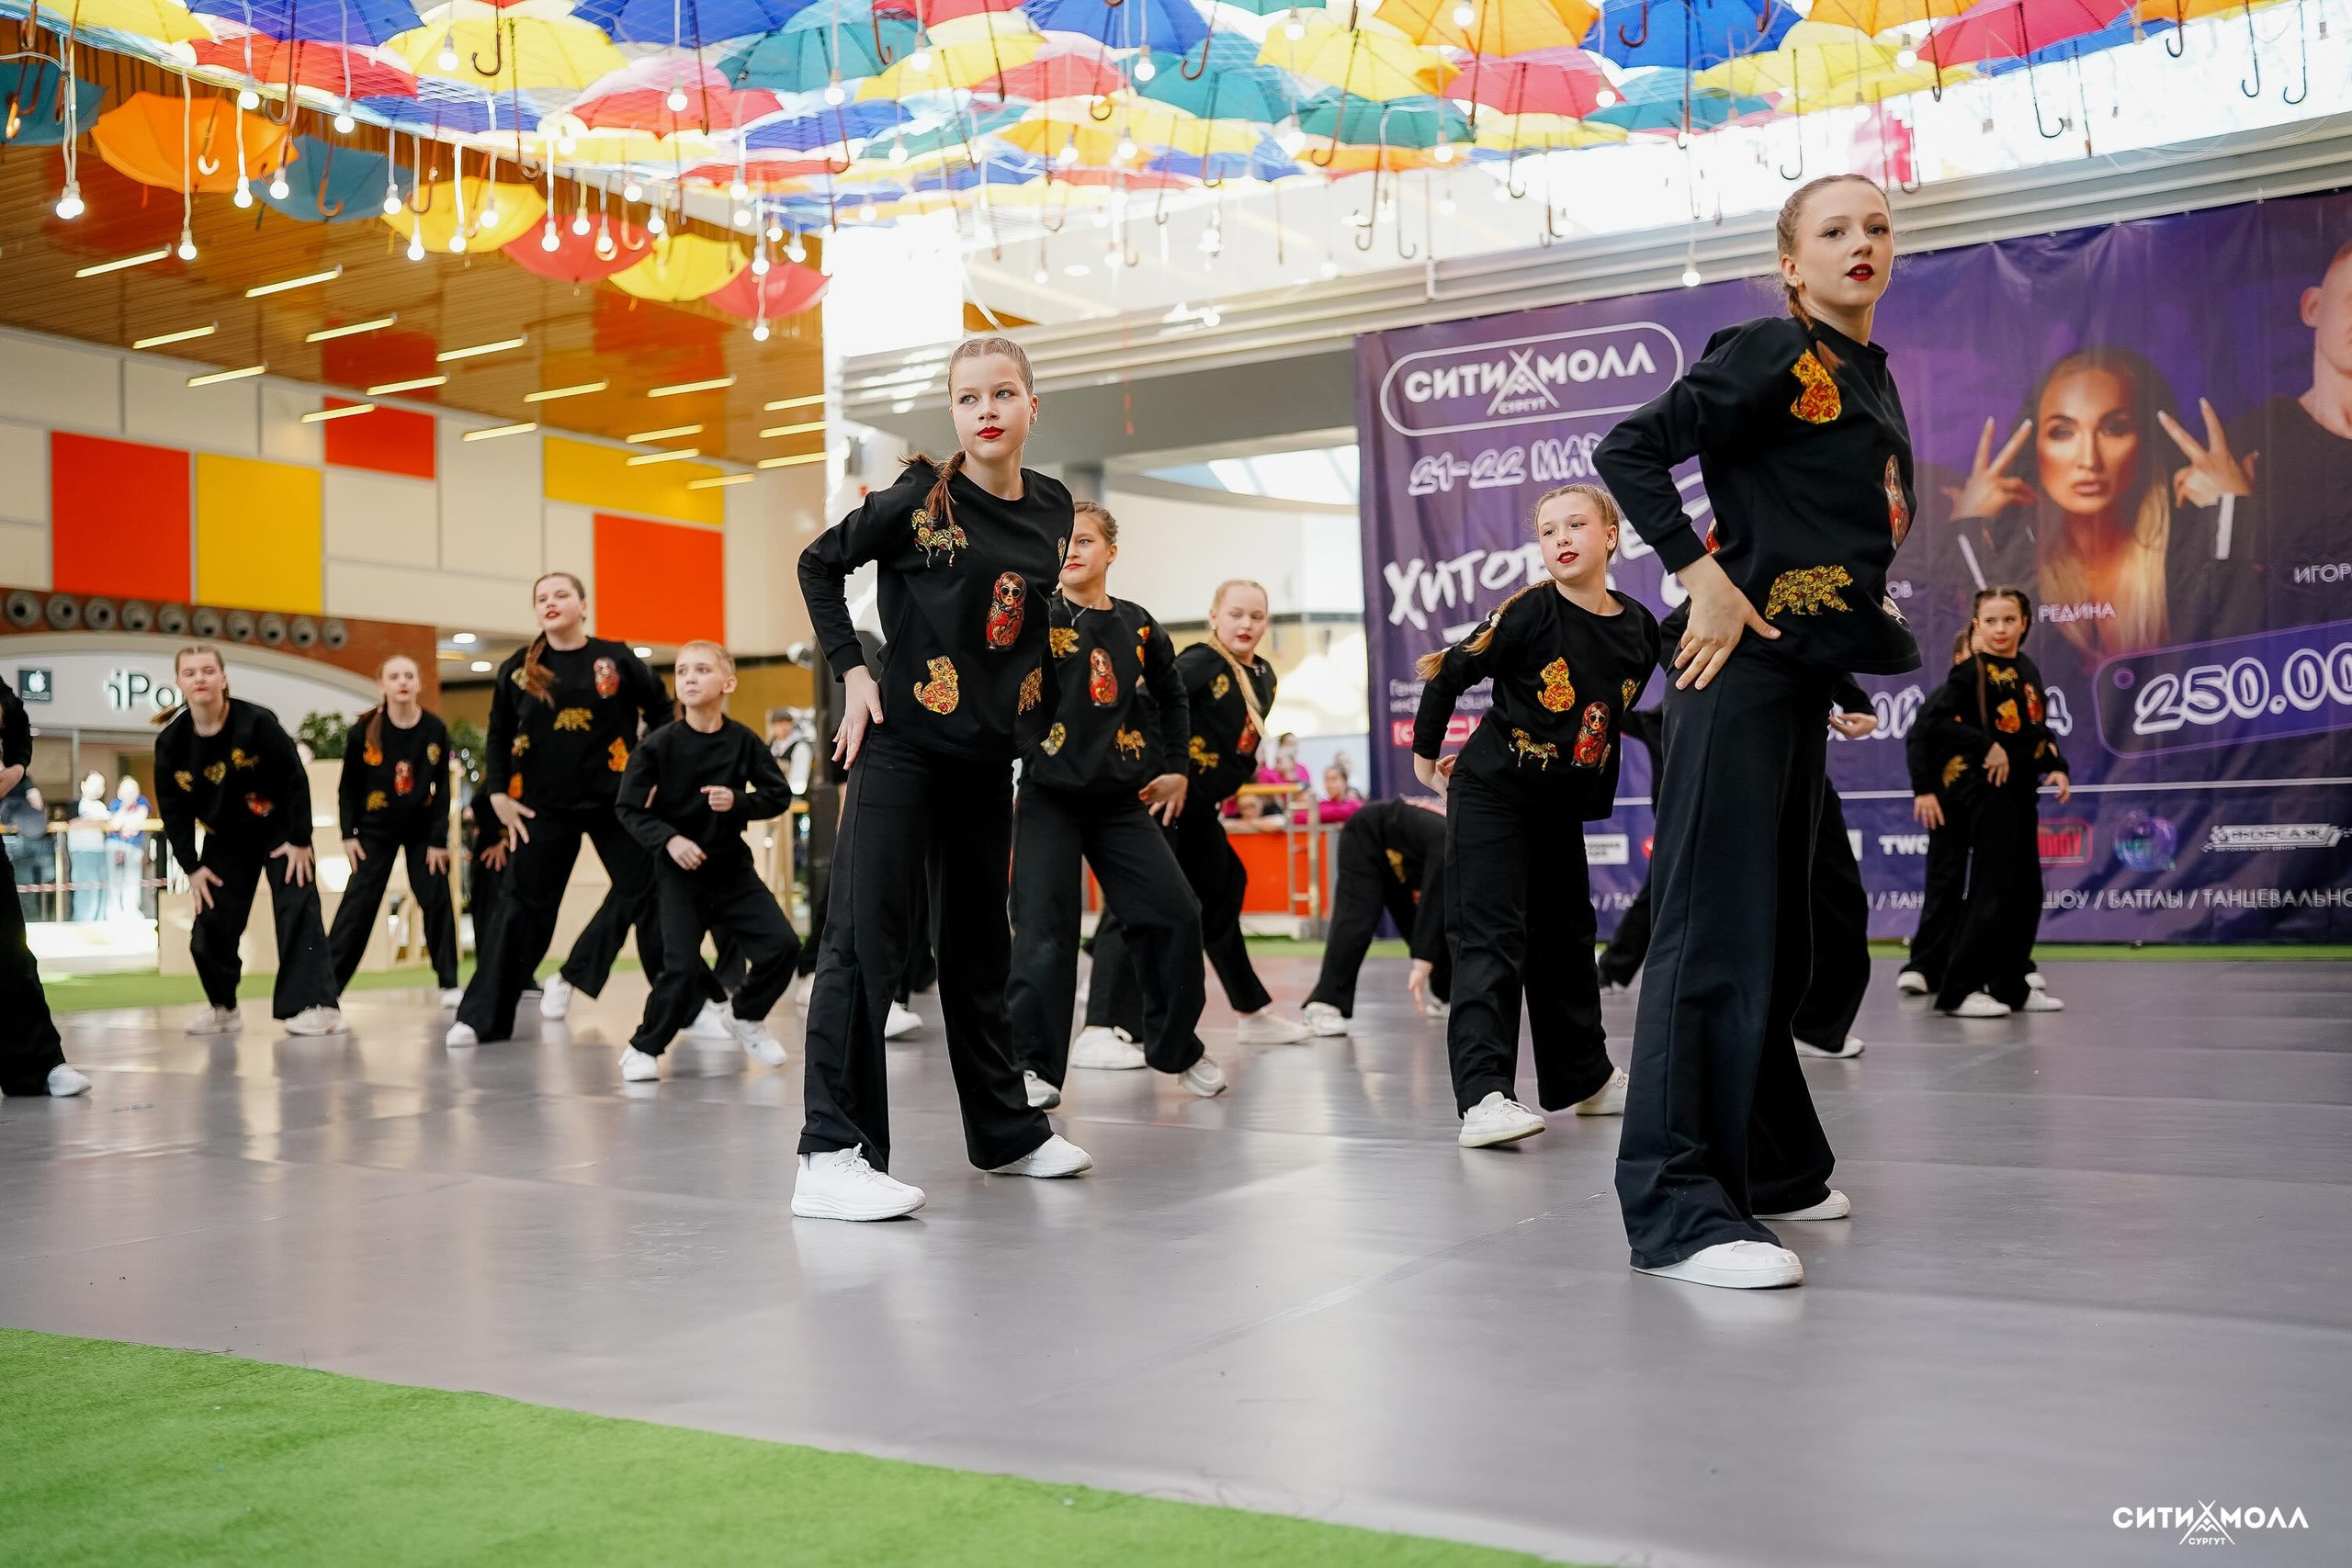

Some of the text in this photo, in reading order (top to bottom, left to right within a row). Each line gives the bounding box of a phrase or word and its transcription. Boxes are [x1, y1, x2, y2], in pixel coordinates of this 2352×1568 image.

[1404, 341, 1657, 403] СИТИ МОЛЛ
[1408, 432, 1604, 496] 21-22 МАР
[2108, 888, 2184, 908] БАТТЛЫ
